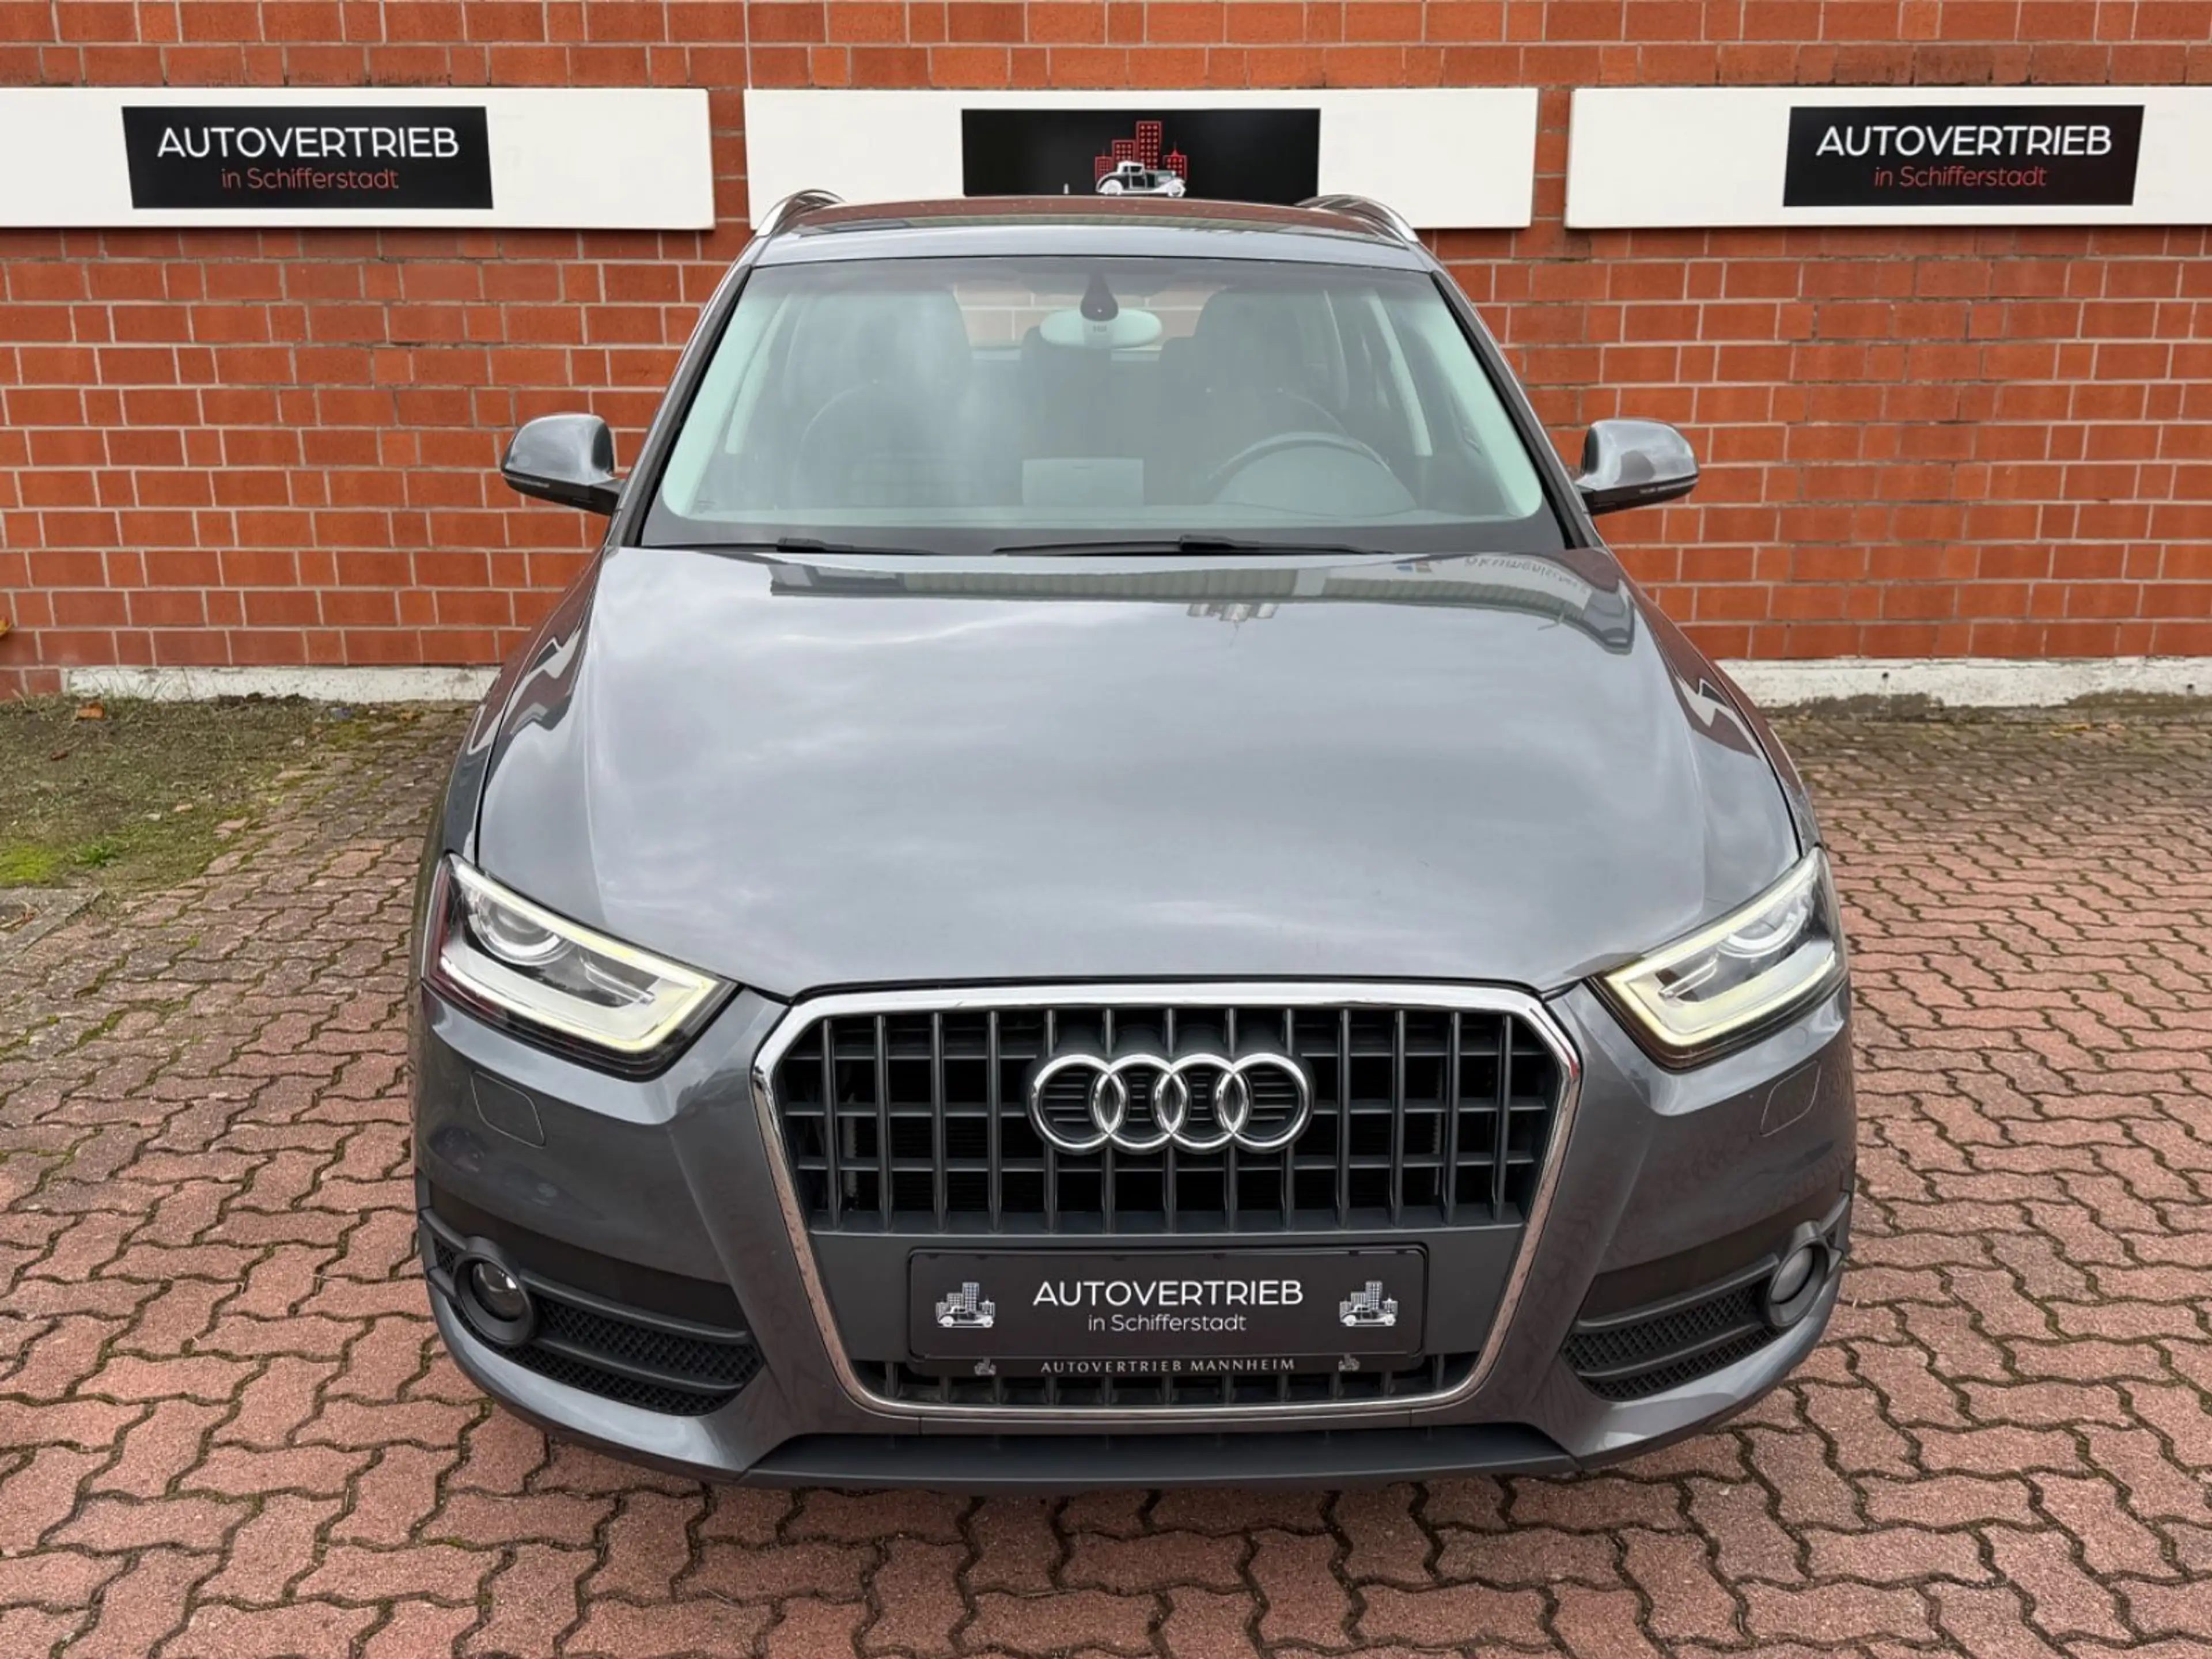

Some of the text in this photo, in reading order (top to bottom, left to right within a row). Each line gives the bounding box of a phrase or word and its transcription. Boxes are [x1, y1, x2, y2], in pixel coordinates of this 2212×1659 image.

[157, 126, 460, 158] AUTOVERTRIEB
[1815, 125, 2112, 157] AUTOVERTRIEB
[221, 167, 399, 189] in Schifferstadt
[1874, 165, 2047, 187] in Schifferstadt
[1032, 1279, 1304, 1307] AUTOVERTRIEB
[1088, 1313, 1247, 1332] in Schifferstadt
[1040, 1359, 1295, 1373] AUTOVERTRIEB MANNHEIM
